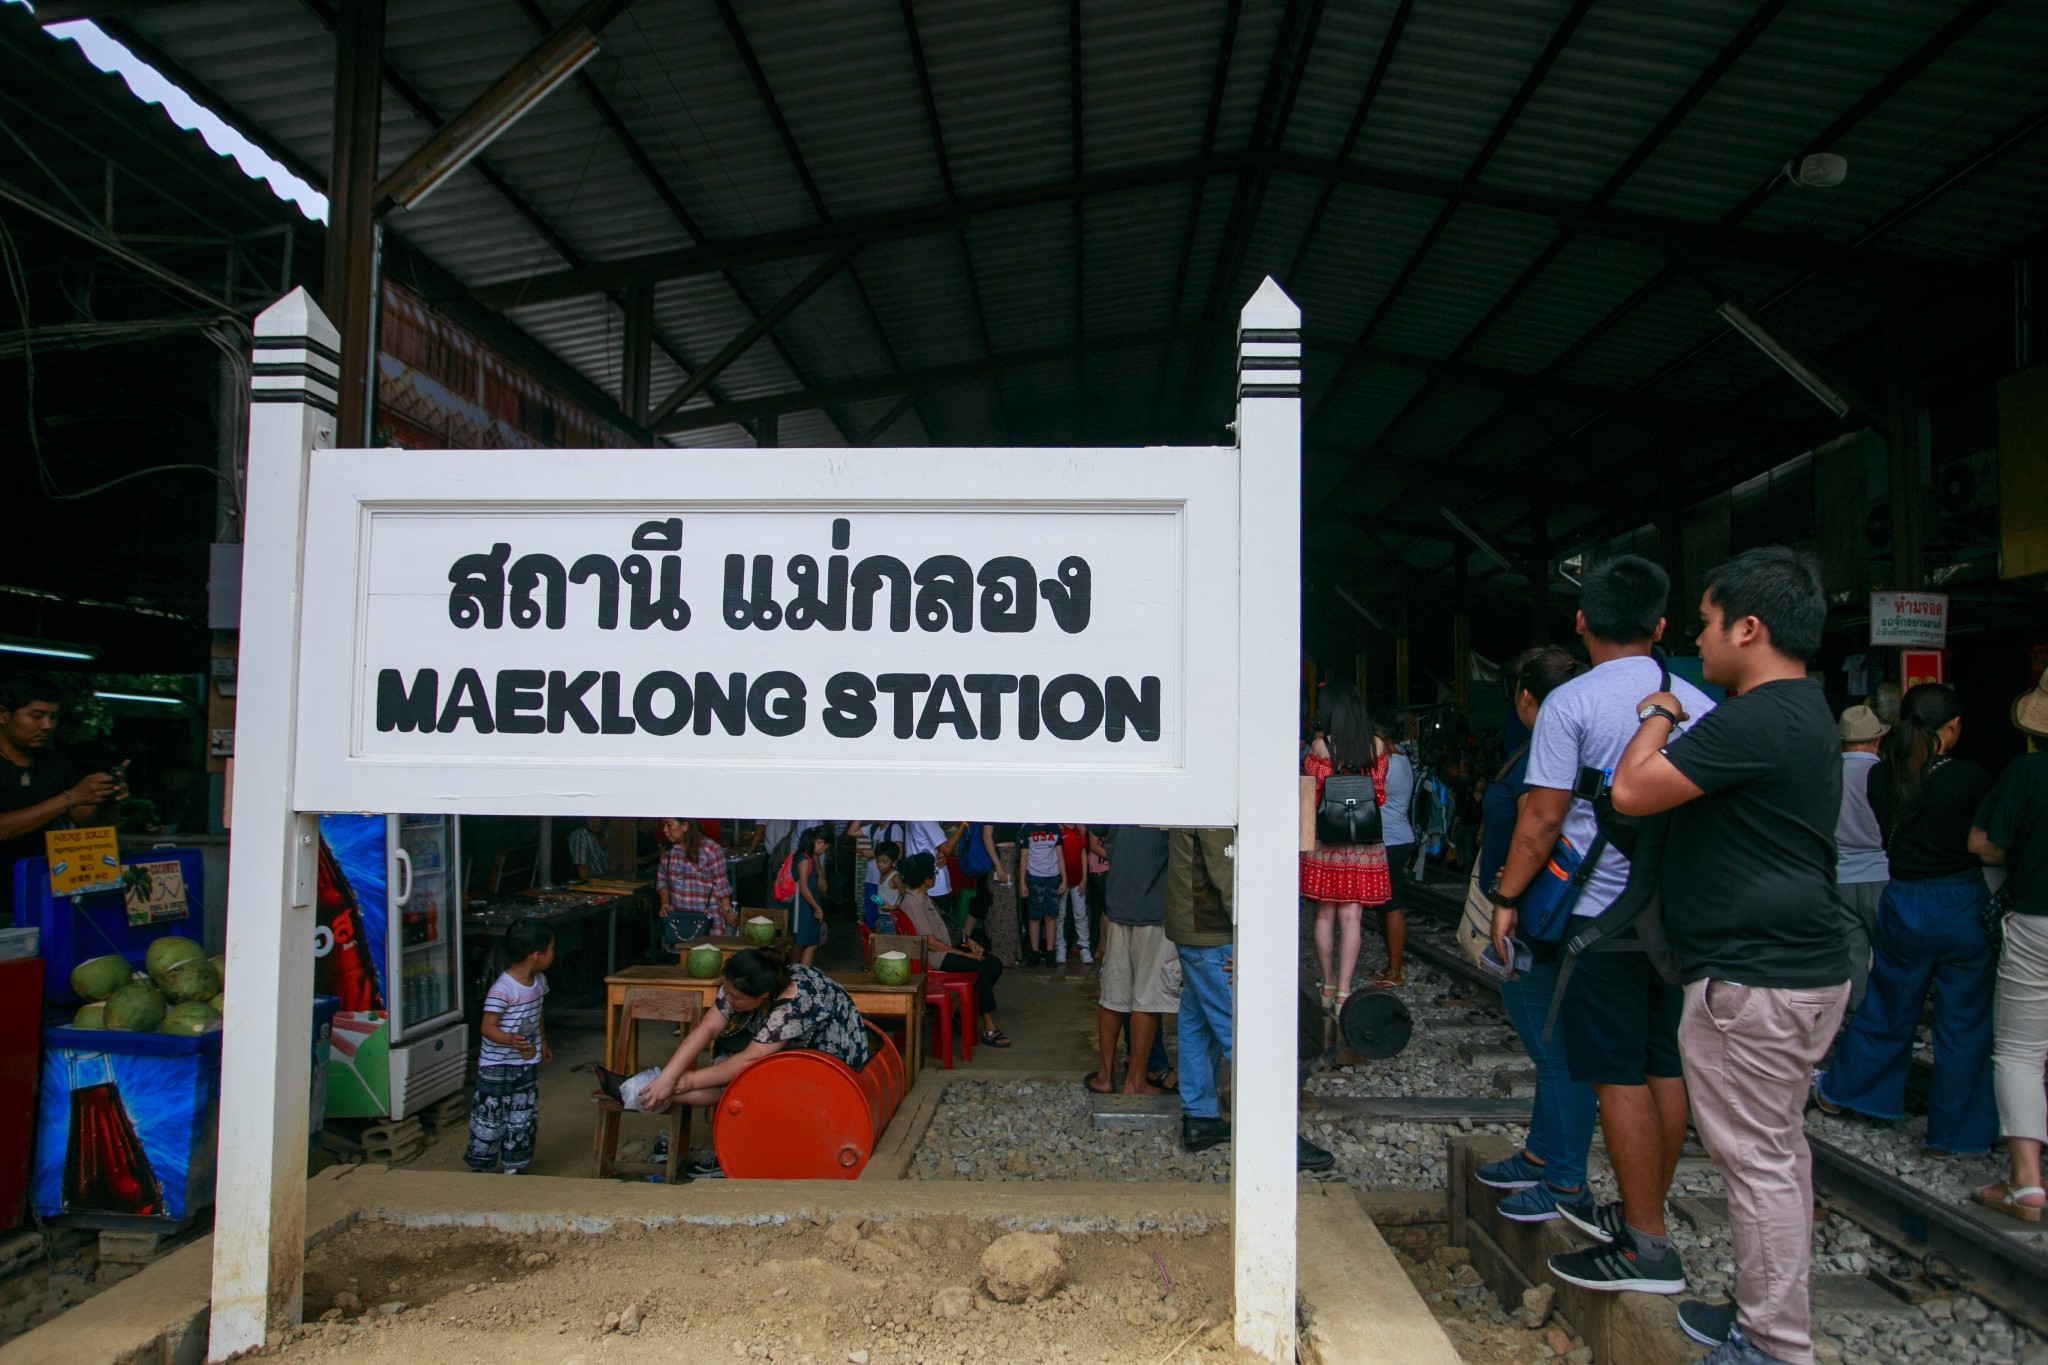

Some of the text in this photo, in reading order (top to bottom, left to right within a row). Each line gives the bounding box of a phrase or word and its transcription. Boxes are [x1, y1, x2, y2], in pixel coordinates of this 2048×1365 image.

[449, 517, 1092, 634] สถานี แม่กลอง
[1893, 595, 1942, 616] ห้ามจอด
[376, 667, 1161, 744] MAEKLONG STATION
[1030, 831, 1055, 843] USA
